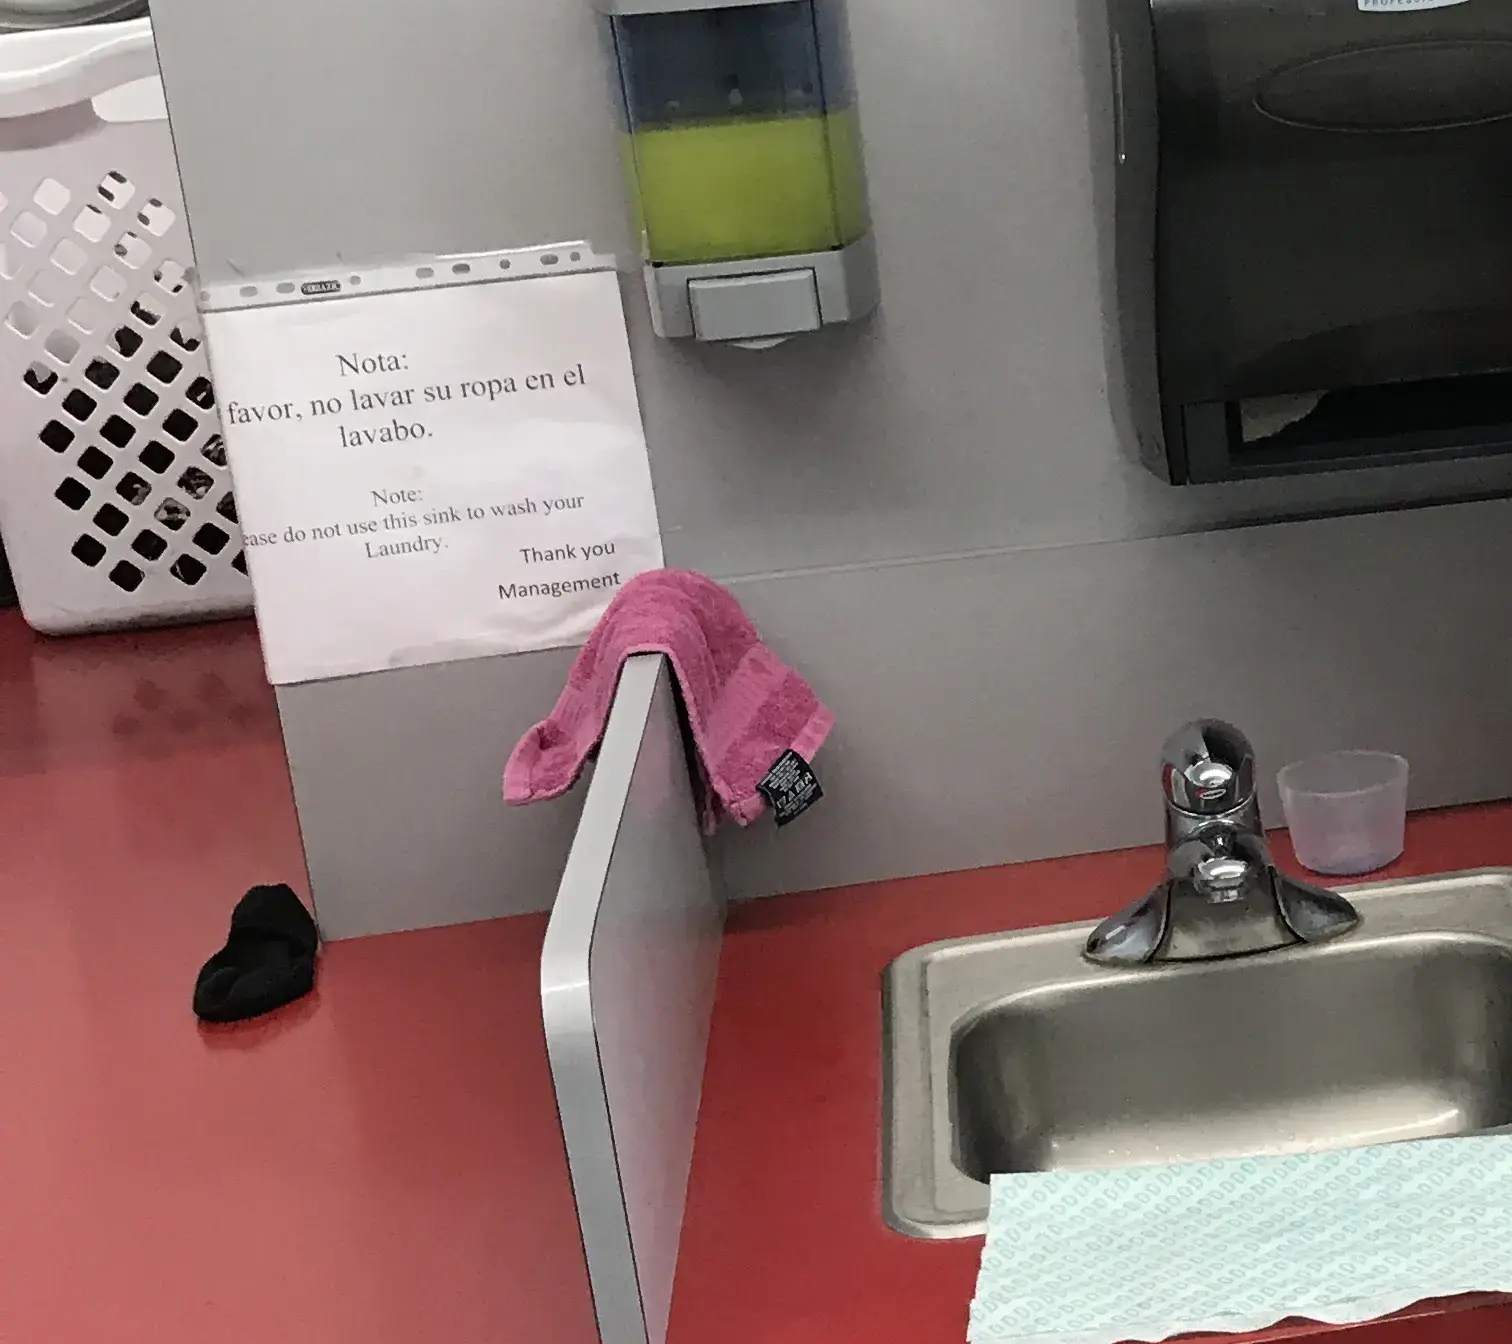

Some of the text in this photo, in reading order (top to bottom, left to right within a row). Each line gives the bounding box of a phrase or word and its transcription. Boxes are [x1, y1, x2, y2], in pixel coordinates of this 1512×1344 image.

[335, 352, 409, 376] Nota:
[227, 363, 587, 425] favor, no lavar su ropa en el
[339, 420, 434, 448] lavabo.
[371, 485, 423, 508] Note:
[283, 523, 306, 544] do
[311, 521, 342, 541] not
[347, 517, 378, 535] use
[383, 510, 418, 531] this
[422, 505, 461, 526] sink
[467, 503, 486, 522] to
[490, 497, 537, 518] wash
[542, 493, 585, 515] your
[365, 533, 449, 559] Laundry.
[520, 541, 615, 565] Thank you
[498, 571, 622, 600] Management
